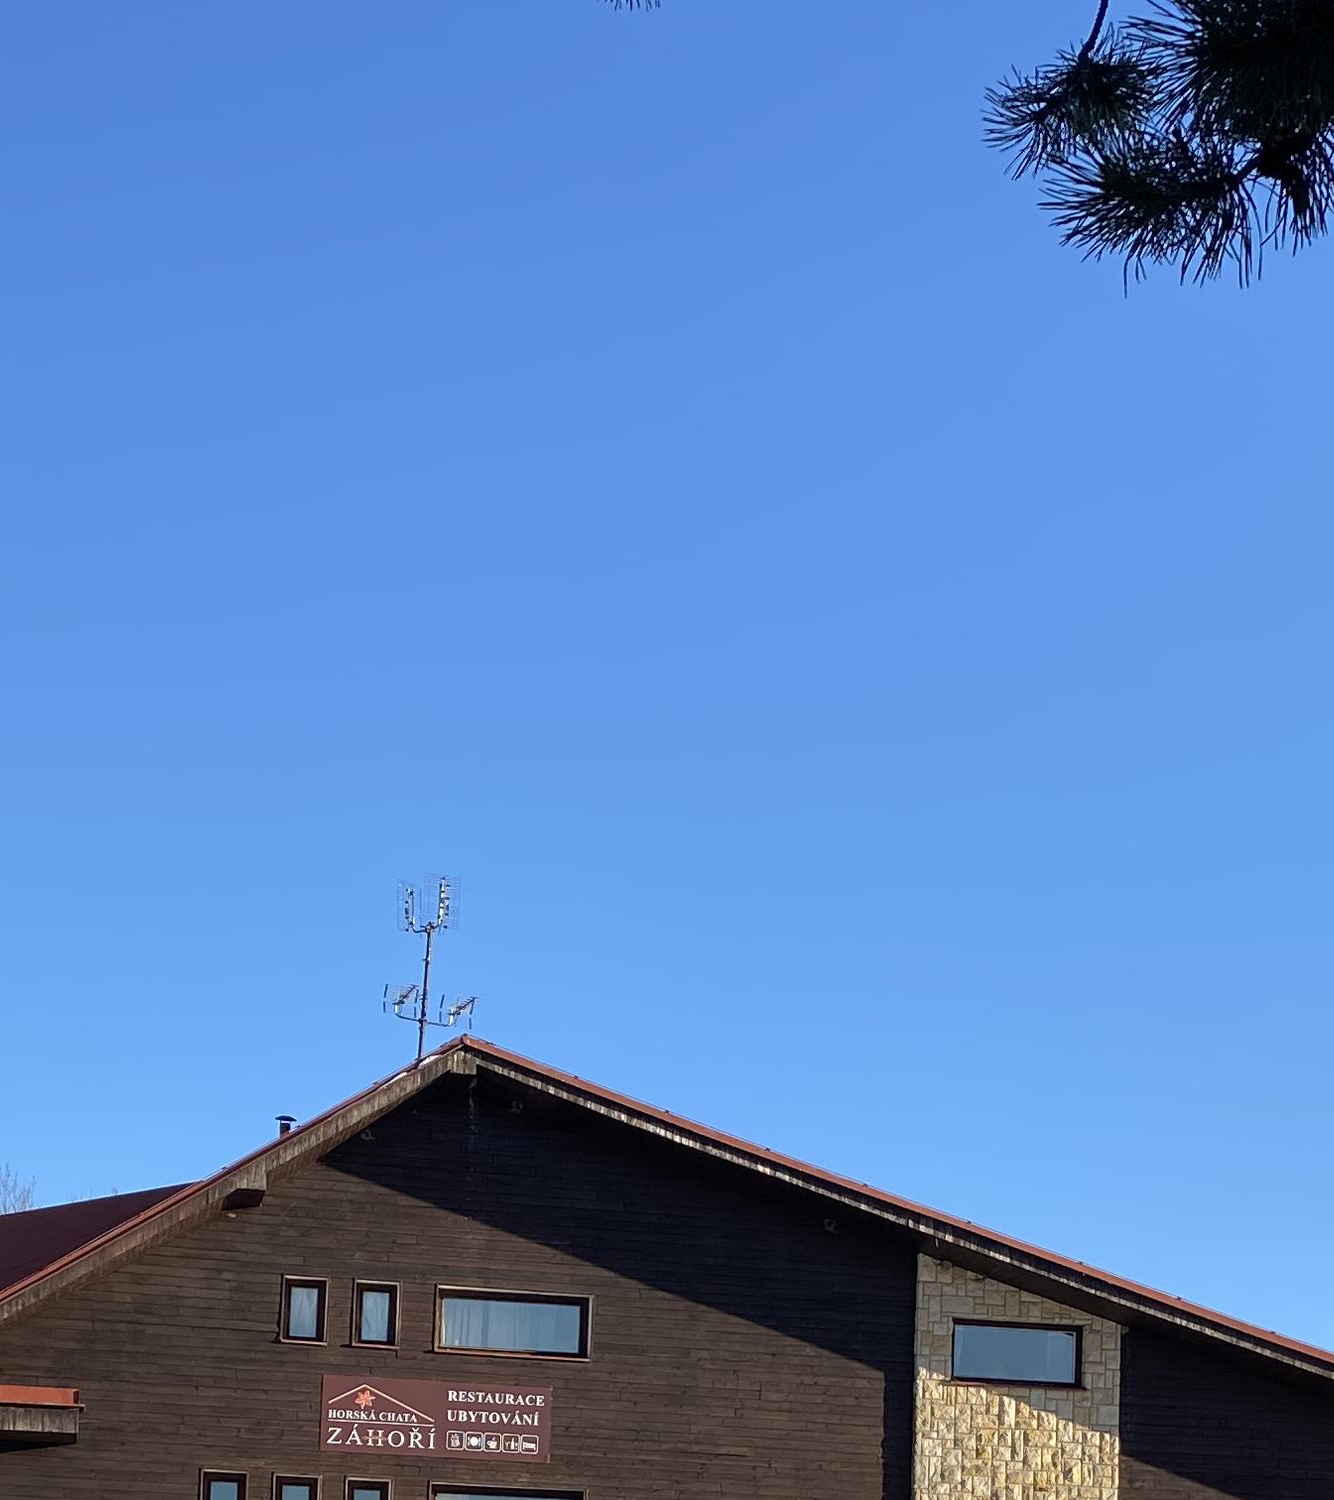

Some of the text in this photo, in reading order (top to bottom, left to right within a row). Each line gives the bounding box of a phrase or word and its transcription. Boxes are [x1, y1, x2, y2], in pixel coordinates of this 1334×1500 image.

[447, 1390, 545, 1407] RESTAURACE
[328, 1409, 417, 1423] HORSKÁ CHATA
[447, 1409, 539, 1426] UBYTOVÁNÍ
[326, 1424, 436, 1449] ZÁHOŘÍ
